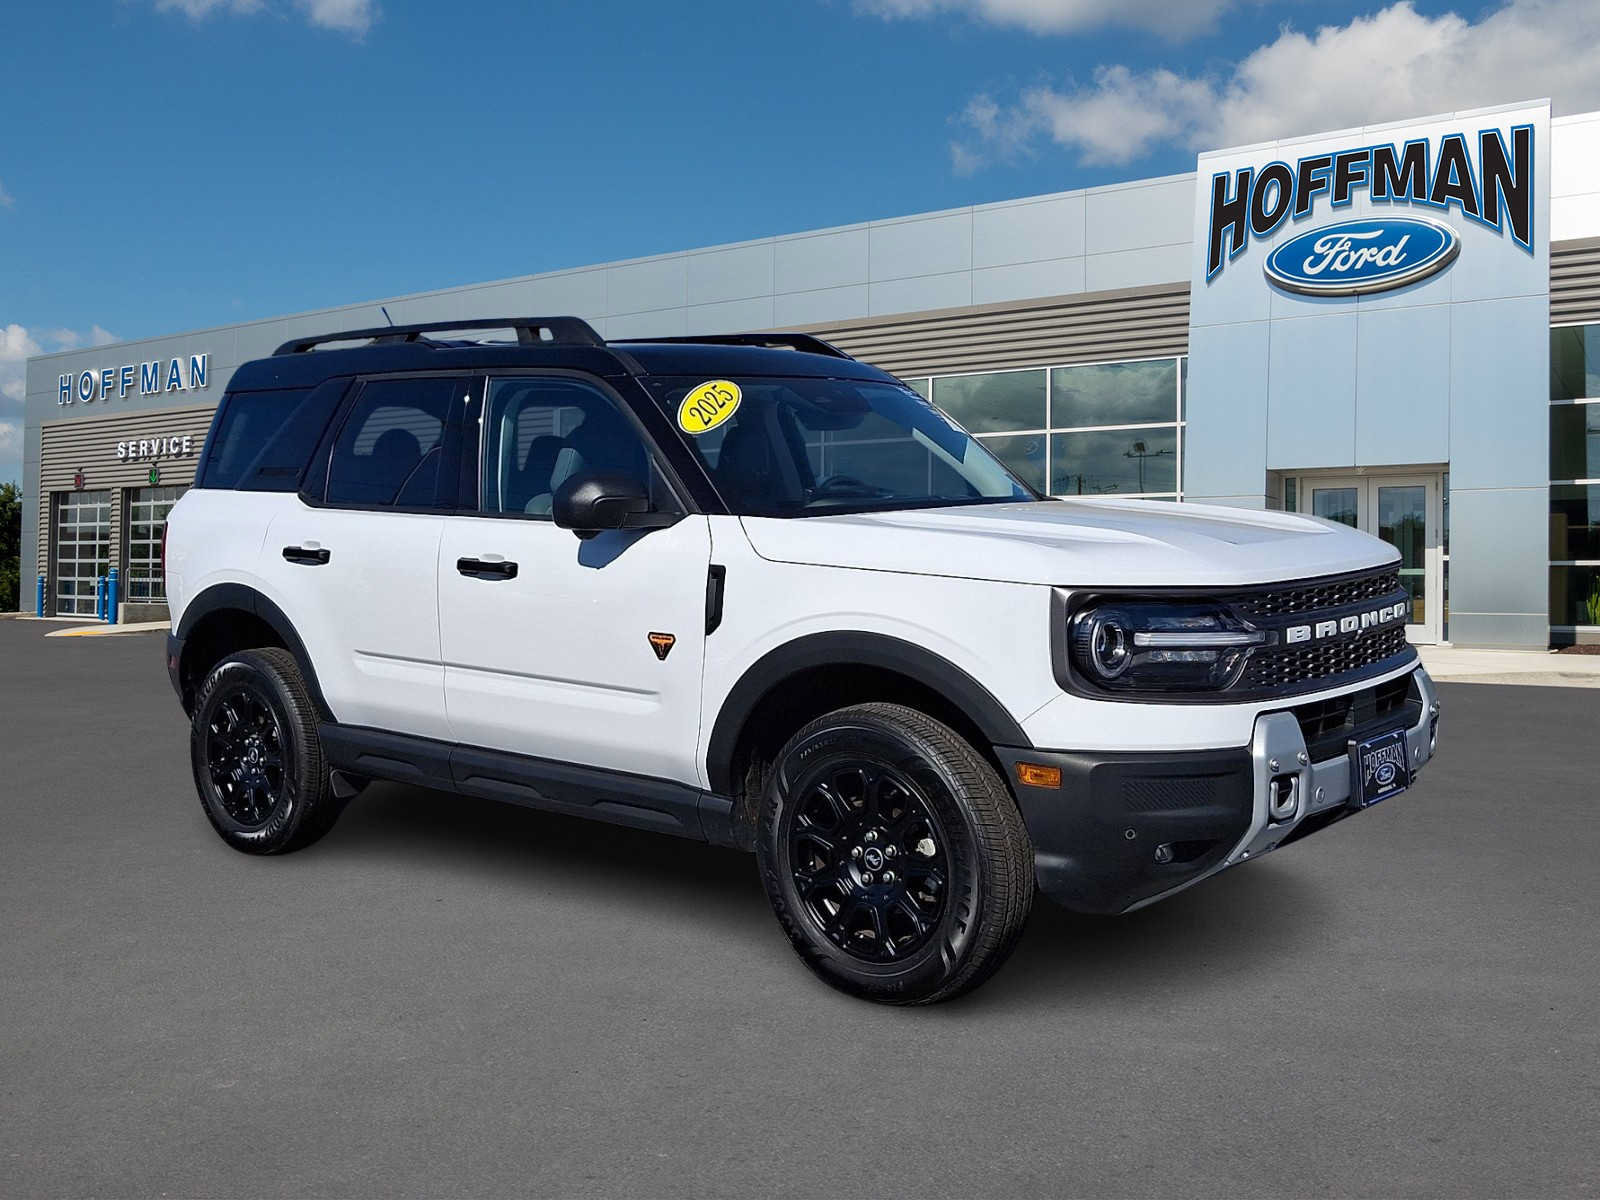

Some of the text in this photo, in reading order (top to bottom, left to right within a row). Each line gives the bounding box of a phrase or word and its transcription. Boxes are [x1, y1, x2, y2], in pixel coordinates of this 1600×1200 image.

[1206, 123, 1535, 282] HOFFMAN
[1303, 228, 1409, 276] Ford
[58, 354, 208, 405] HOFFMAN
[689, 384, 734, 426] 2025
[117, 436, 192, 458] SERVICE
[1286, 602, 1406, 644] BRONCO
[1363, 742, 1405, 787] HOFFMAN
